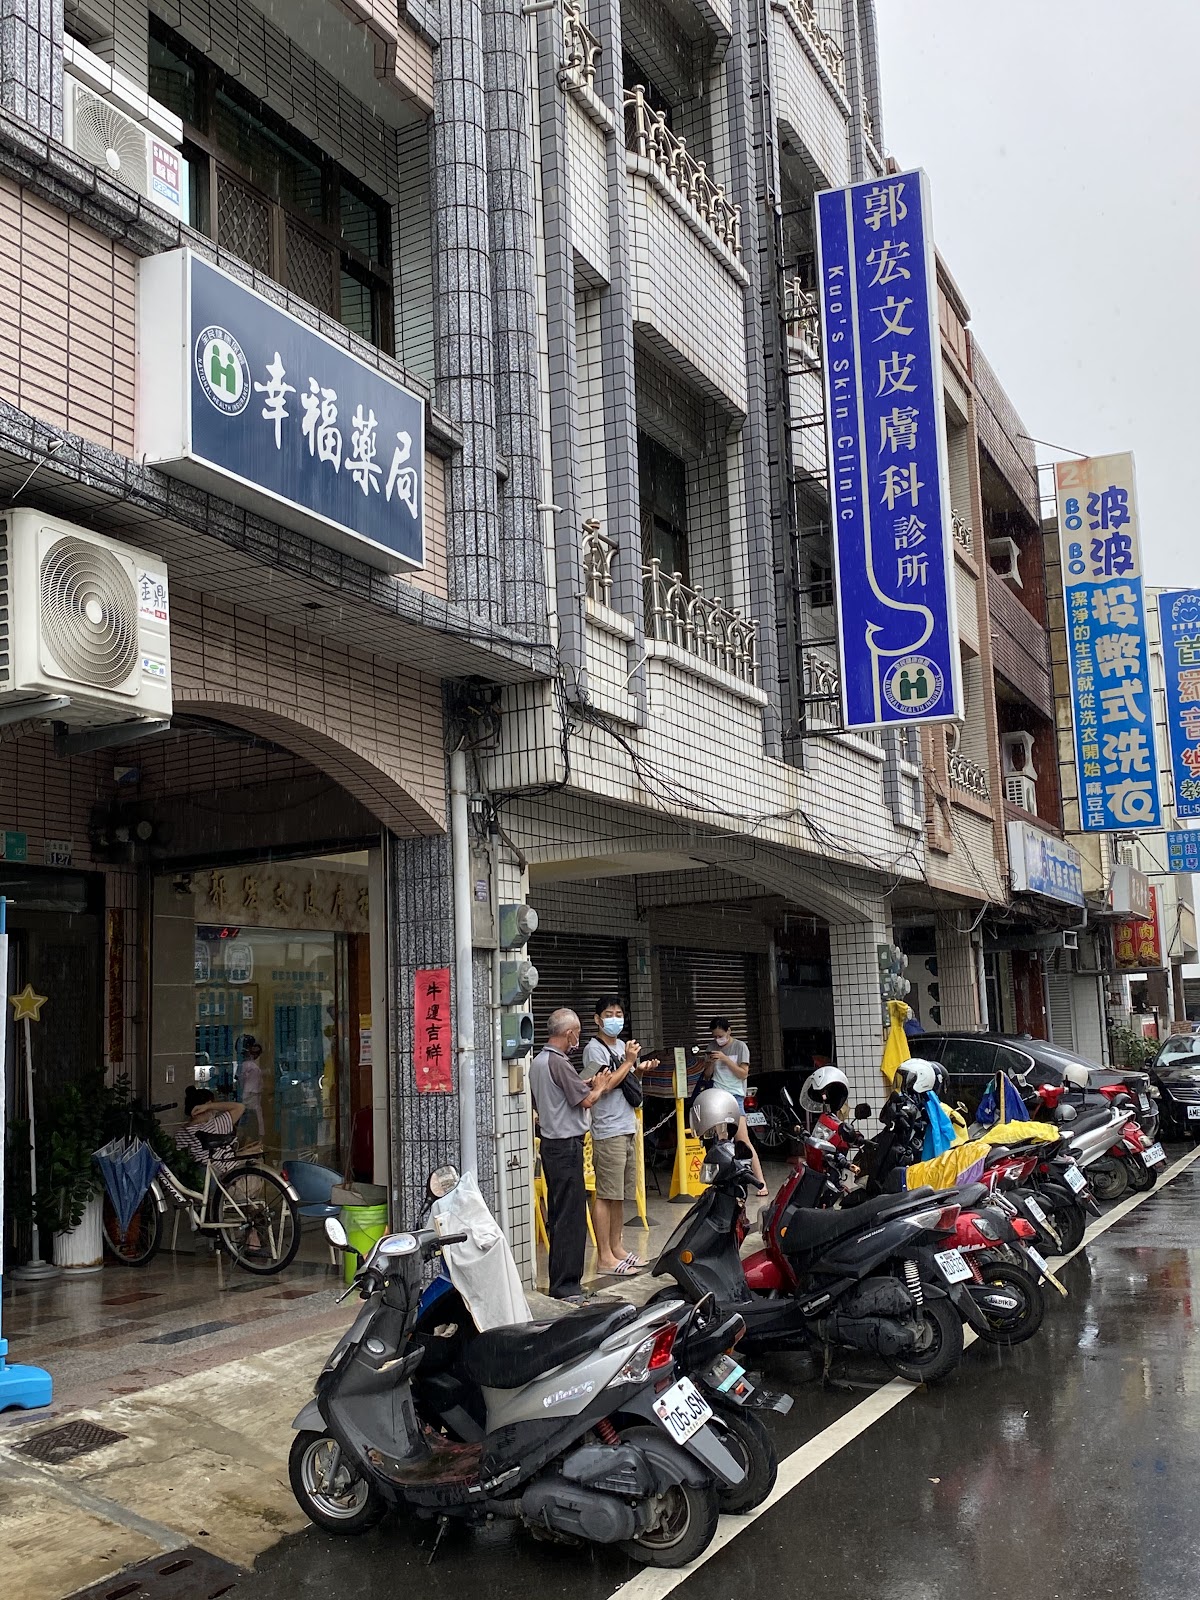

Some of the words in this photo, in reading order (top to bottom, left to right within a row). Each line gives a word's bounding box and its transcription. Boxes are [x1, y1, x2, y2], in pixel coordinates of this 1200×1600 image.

[828, 265, 846, 343] Kuo's
[833, 358, 852, 419] Skin
[863, 182, 931, 588] 郭宏文皮膚科診所
[253, 351, 418, 520] 幸福藥局
[837, 435, 857, 520] Clinic
[1086, 485, 1135, 576] 波波
[138, 573, 168, 610] 金鼎
[1091, 585, 1155, 823] 投幣式洗衣
[1085, 781, 1105, 828] 麻豆店
[425, 981, 443, 1067] 牛運吉祥
[664, 1389, 709, 1437] 705-JSN
